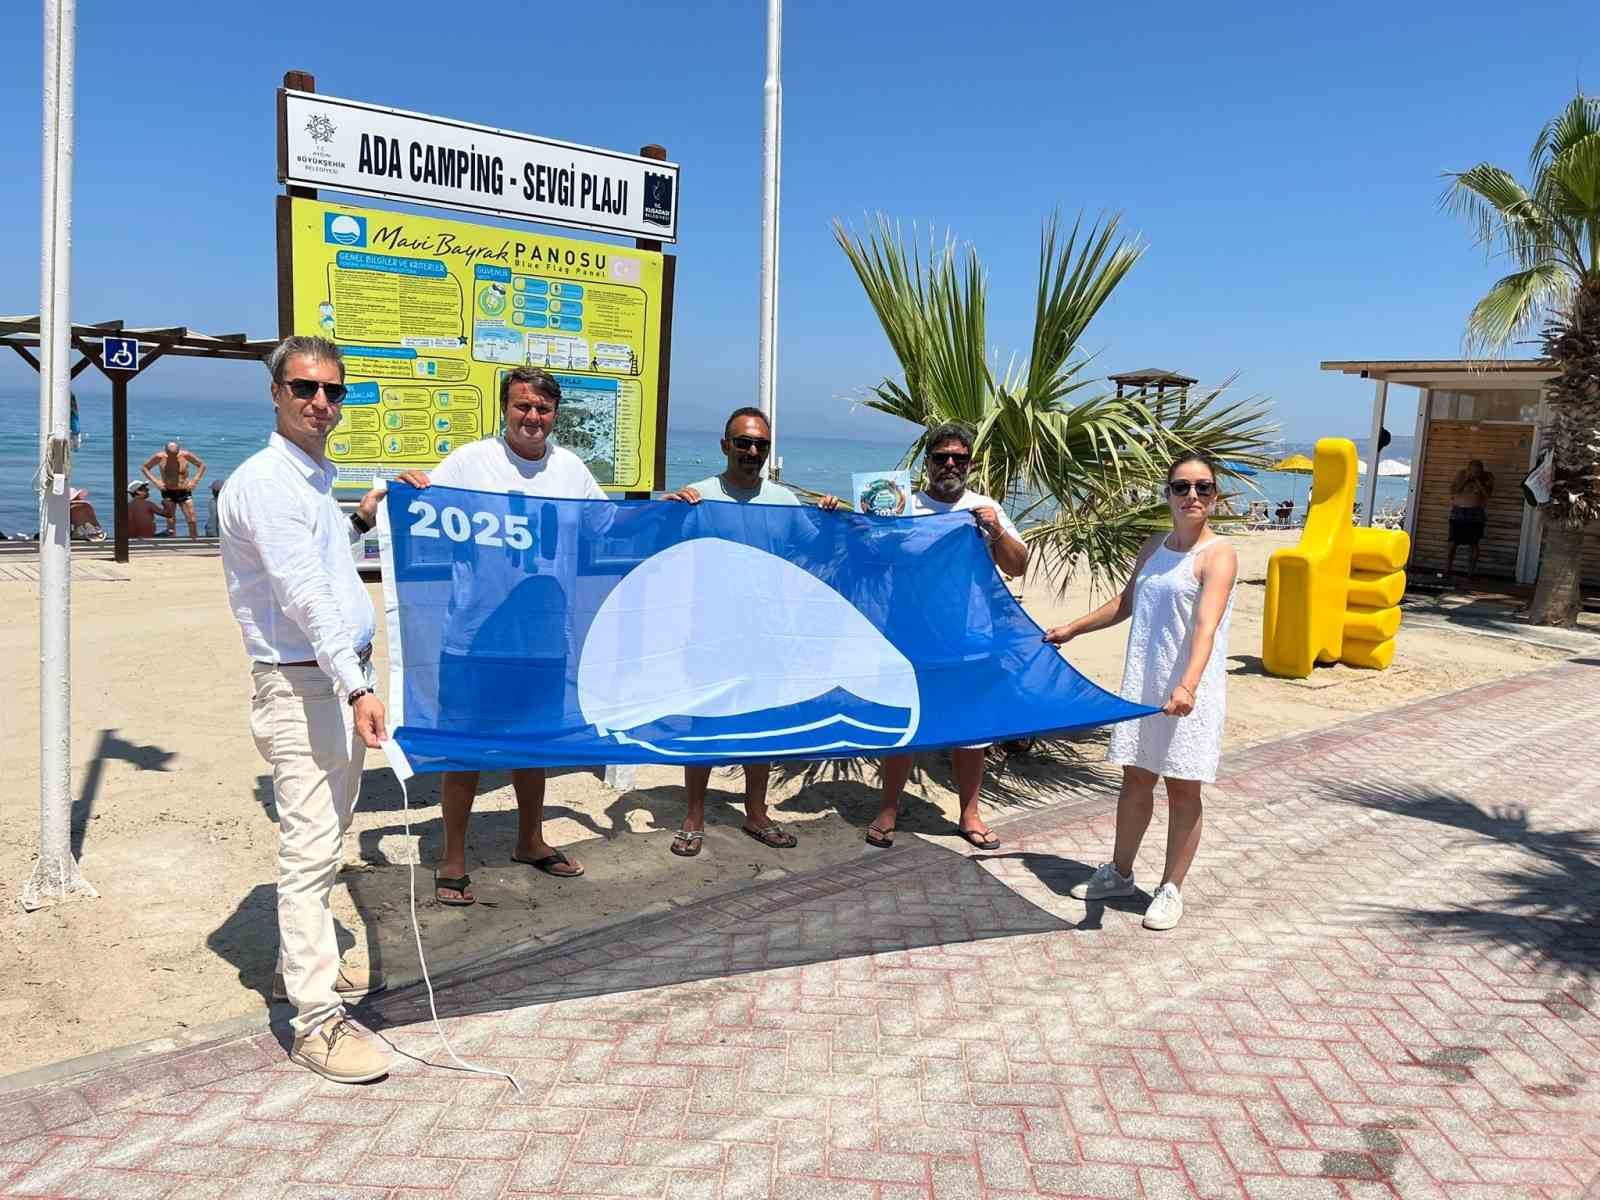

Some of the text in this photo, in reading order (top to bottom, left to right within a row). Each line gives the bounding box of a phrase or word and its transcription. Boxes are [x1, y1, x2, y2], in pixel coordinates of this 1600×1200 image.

[358, 133, 628, 216] ADA CAMPİNG - SEVGİ PLAJI
[373, 226, 605, 269] Mavi Bayrak PANOSU
[514, 259, 605, 278] Blue Flag Panel
[407, 499, 533, 551] 2025
